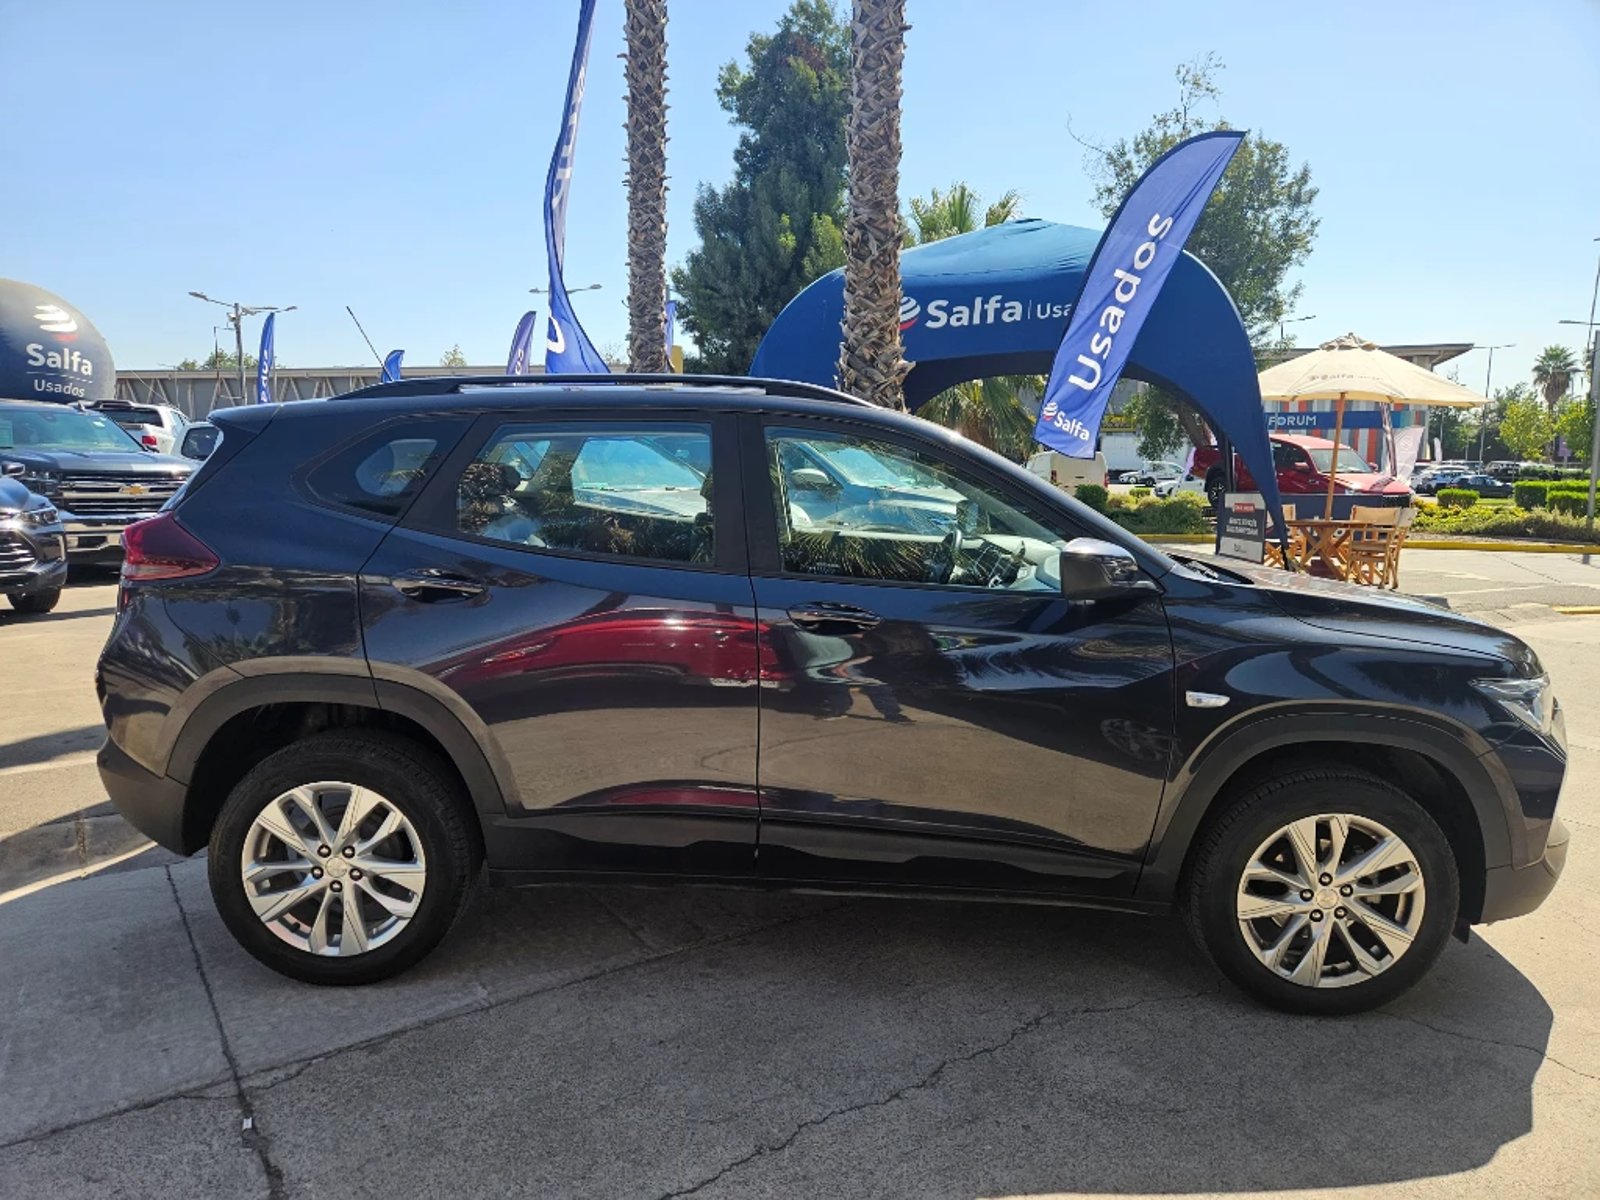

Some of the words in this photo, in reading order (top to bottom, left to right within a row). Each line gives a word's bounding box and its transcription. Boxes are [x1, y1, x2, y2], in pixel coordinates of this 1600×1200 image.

[925, 294, 1023, 329] Salfa
[1068, 213, 1174, 391] Usados
[26, 343, 93, 376] Salfa
[34, 379, 86, 398] Usados
[1053, 412, 1091, 442] Salfa
[1268, 415, 1317, 426] FORUM
